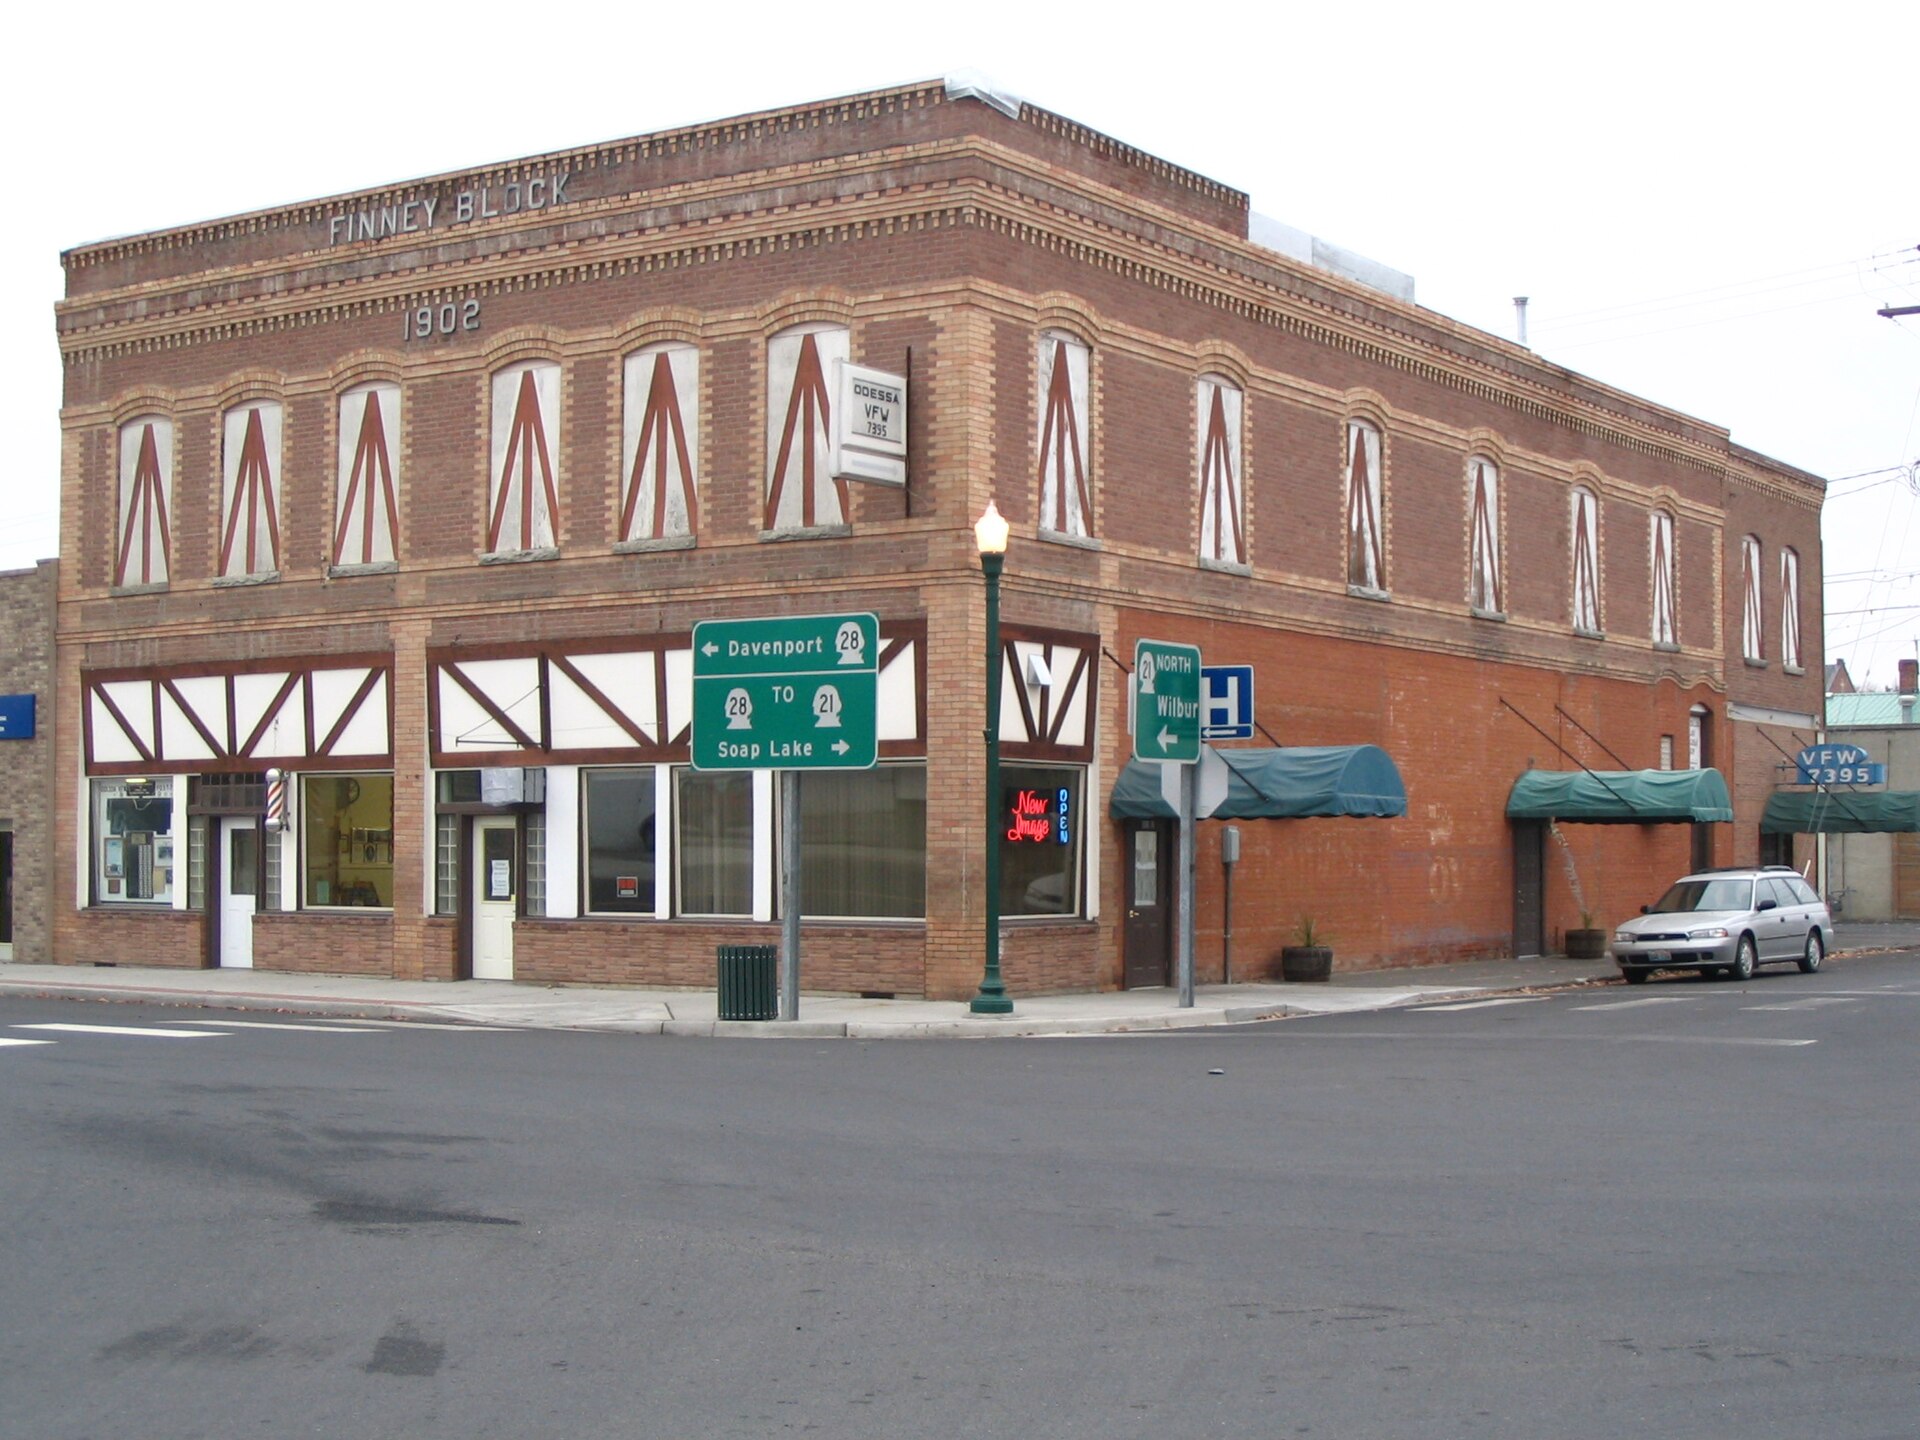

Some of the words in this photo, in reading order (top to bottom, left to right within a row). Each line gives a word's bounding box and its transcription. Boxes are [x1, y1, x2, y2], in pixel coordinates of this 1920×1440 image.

[330, 197, 438, 245] FINNEY
[456, 173, 571, 222] BLOCK
[404, 300, 481, 341] 1902
[853, 384, 899, 405] ODESSA
[865, 403, 889, 422] VFW
[867, 421, 887, 437] 7395
[728, 636, 823, 657] Davenport
[840, 630, 859, 650] 28
[1142, 660, 1151, 680] 21
[1156, 654, 1192, 674] NORTH
[729, 697, 747, 715] 28
[772, 686, 795, 703] TO
[819, 694, 834, 713] 21
[1157, 695, 1199, 718] Wilbur
[1201, 676, 1238, 727] H
[718, 741, 761, 760] Soap
[770, 740, 813, 757] Lake
[1801, 750, 1857, 766] VFW
[1808, 767, 1870, 783] 7395
[1011, 790, 1048, 815] New
[1007, 813, 1050, 842] Image
[1059, 788, 1069, 843] OPEN
